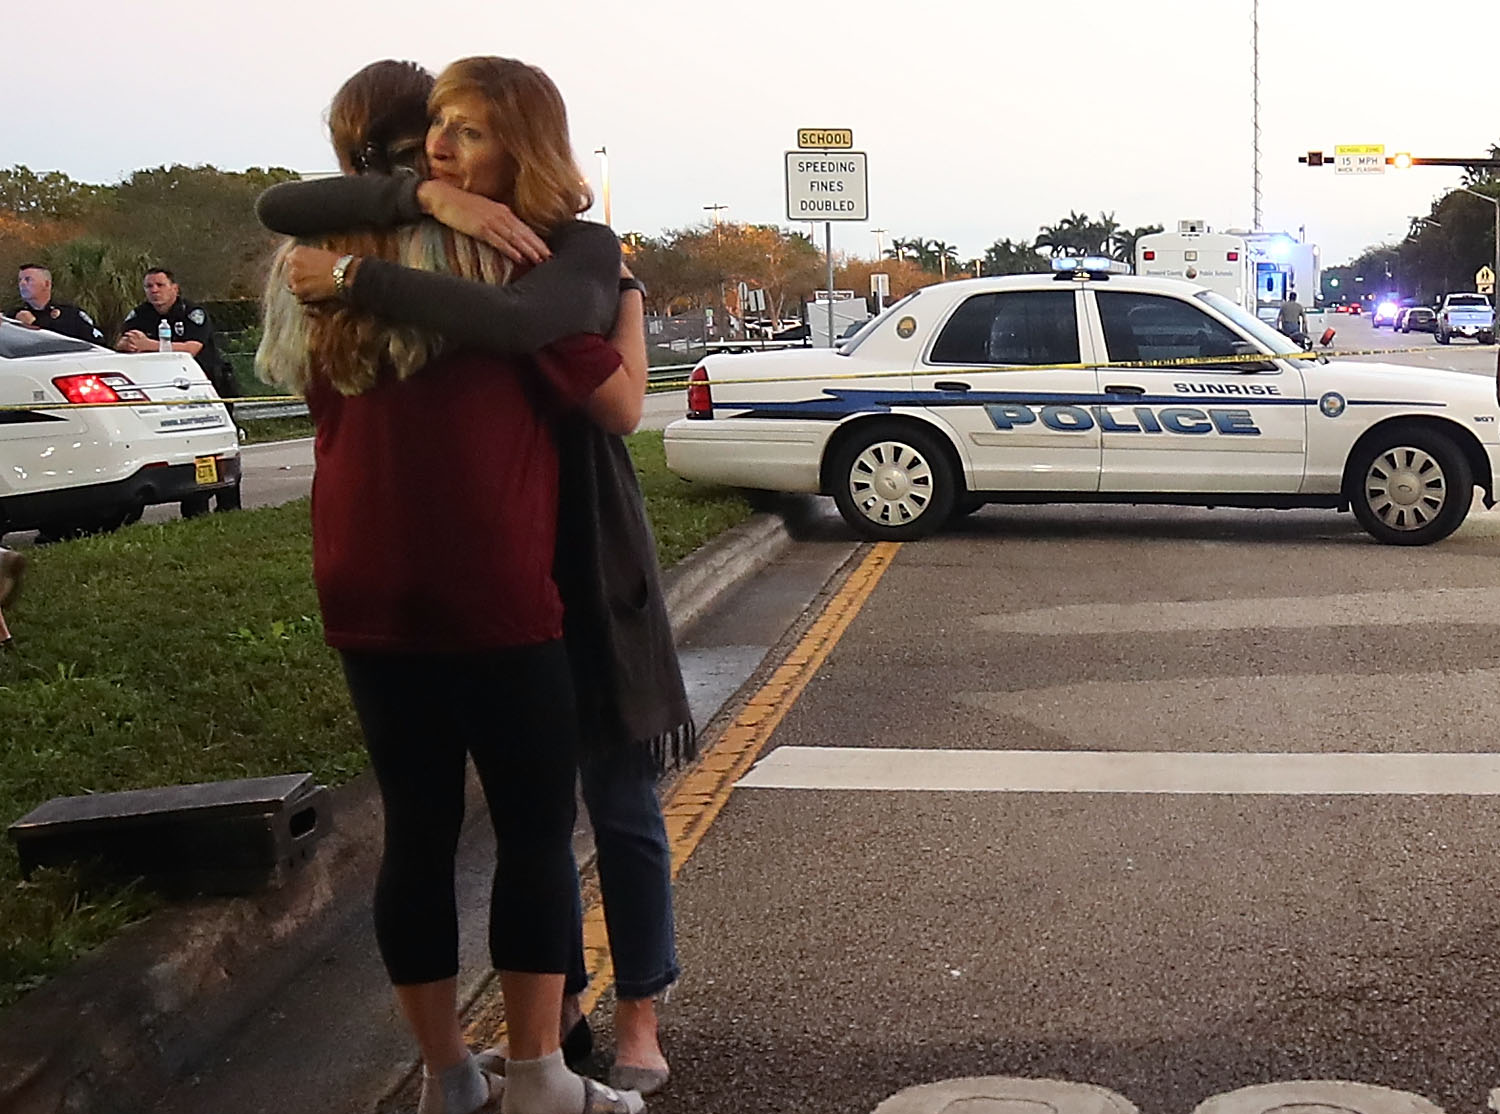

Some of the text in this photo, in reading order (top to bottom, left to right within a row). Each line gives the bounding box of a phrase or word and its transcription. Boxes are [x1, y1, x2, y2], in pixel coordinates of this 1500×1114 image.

[801, 132, 850, 145] SCHOOL
[798, 161, 856, 173] SPEEDING
[1342, 156, 1378, 166] 15 MPH
[810, 180, 844, 192] FINES
[800, 200, 855, 211] DOUBLED
[1173, 382, 1282, 396] SUNRISE
[983, 403, 1262, 436] POLICE
